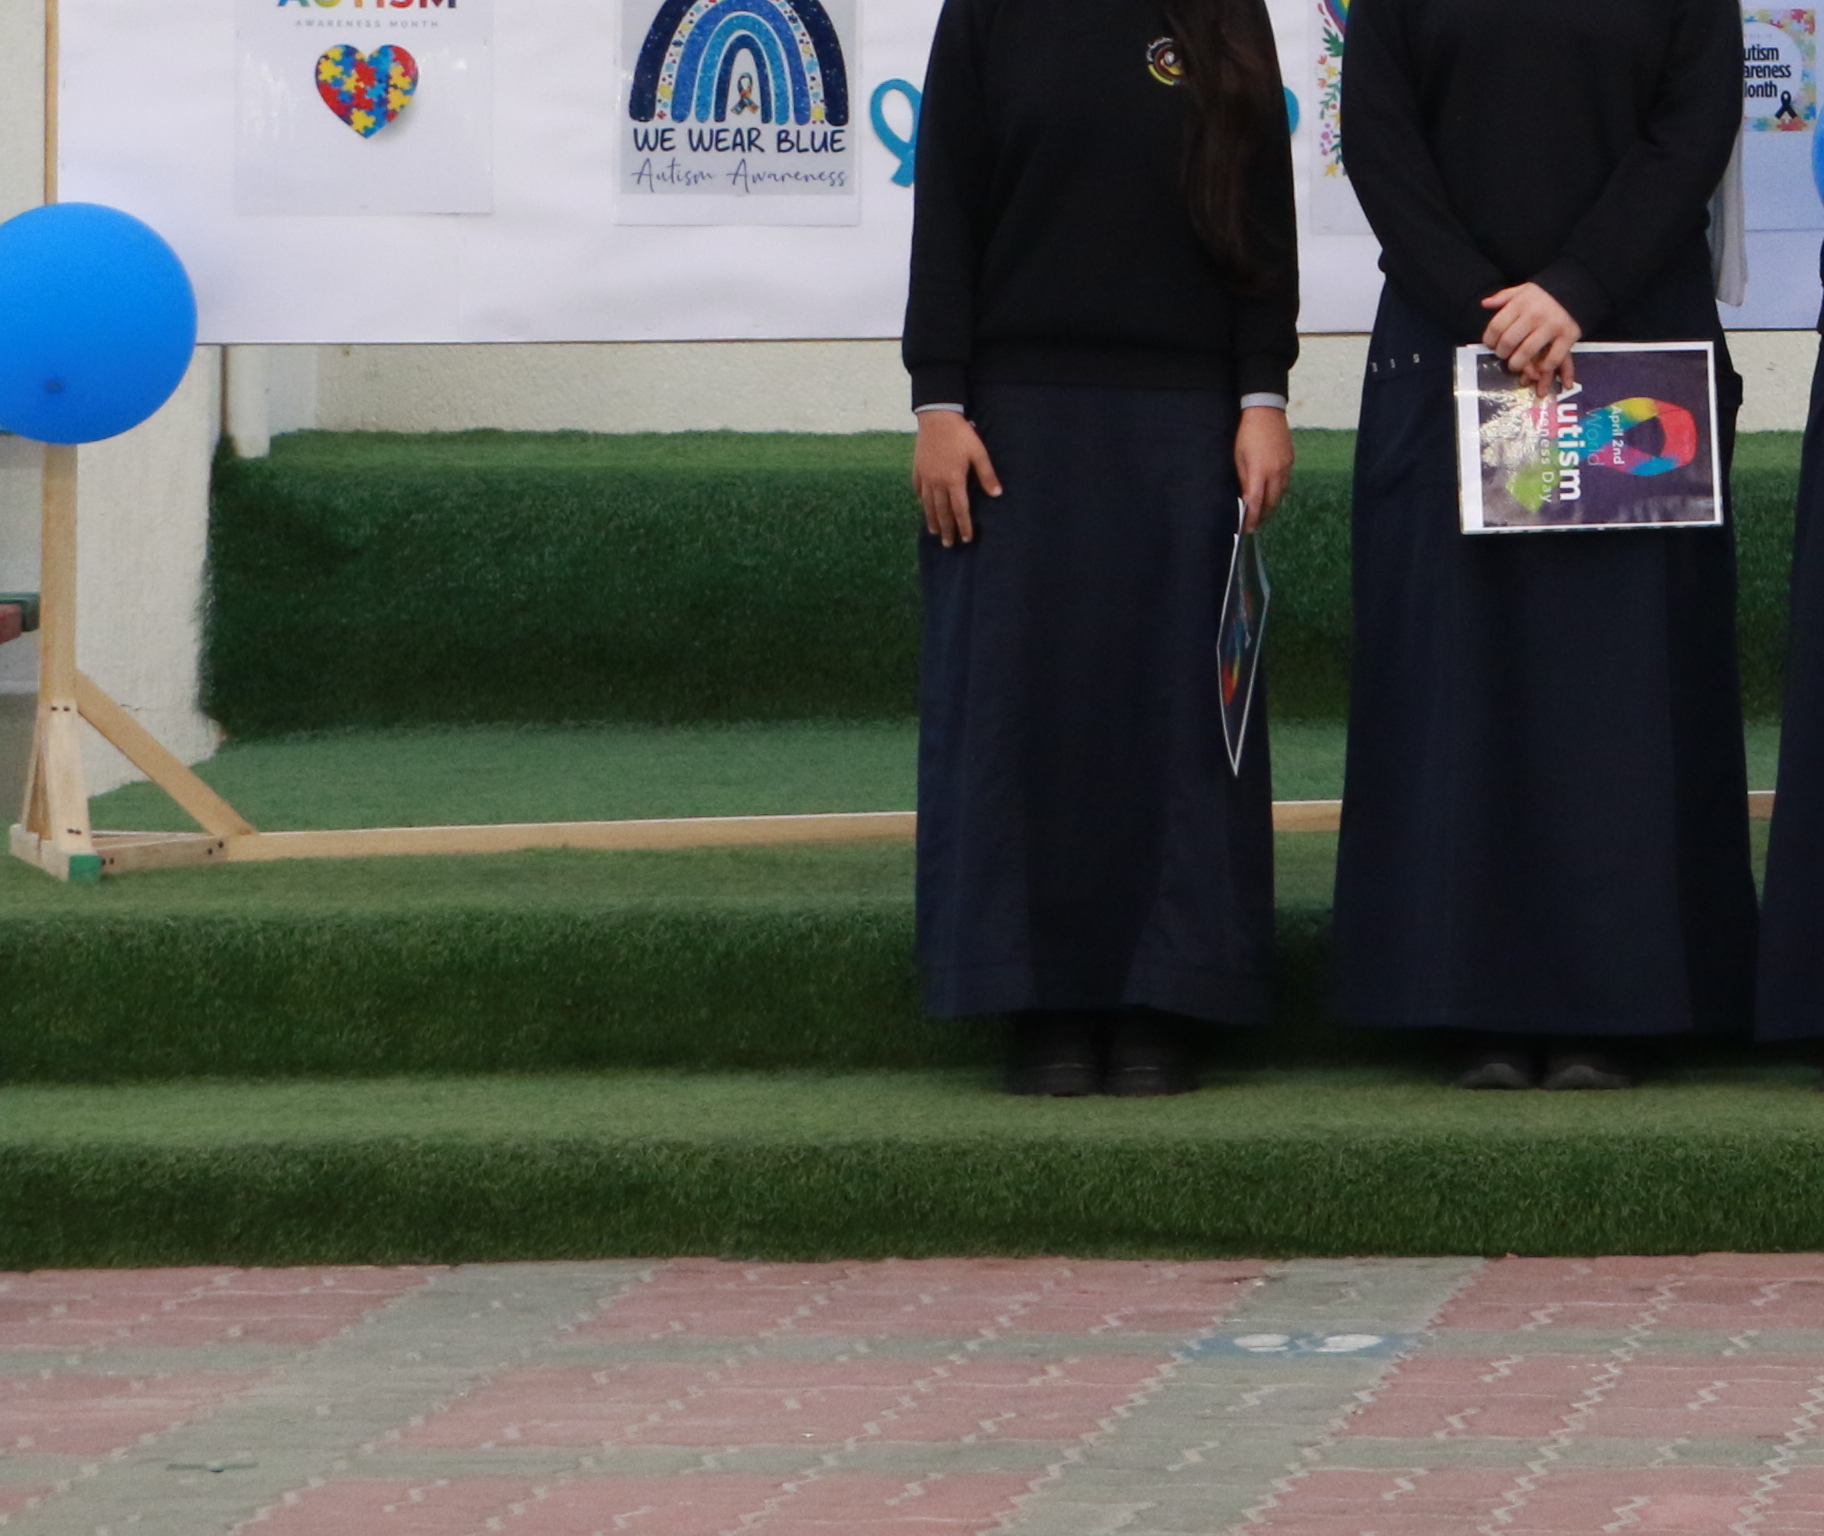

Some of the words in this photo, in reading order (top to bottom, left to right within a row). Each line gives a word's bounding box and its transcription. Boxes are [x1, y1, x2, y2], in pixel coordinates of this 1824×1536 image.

[295, 19, 382, 29] AWARENESS
[389, 19, 439, 29] MONTH
[1744, 44, 1780, 61] utism
[1743, 80, 1778, 98] onth
[633, 127, 676, 152] WE
[688, 127, 765, 153] WEAR
[776, 129, 846, 153] BLUE
[631, 156, 714, 194] Autism
[725, 158, 849, 194] Awareness
[1609, 405, 1624, 437] April
[1585, 407, 1606, 467] World
[1611, 439, 1625, 466] 2nd
[1539, 471, 1555, 503] Day
